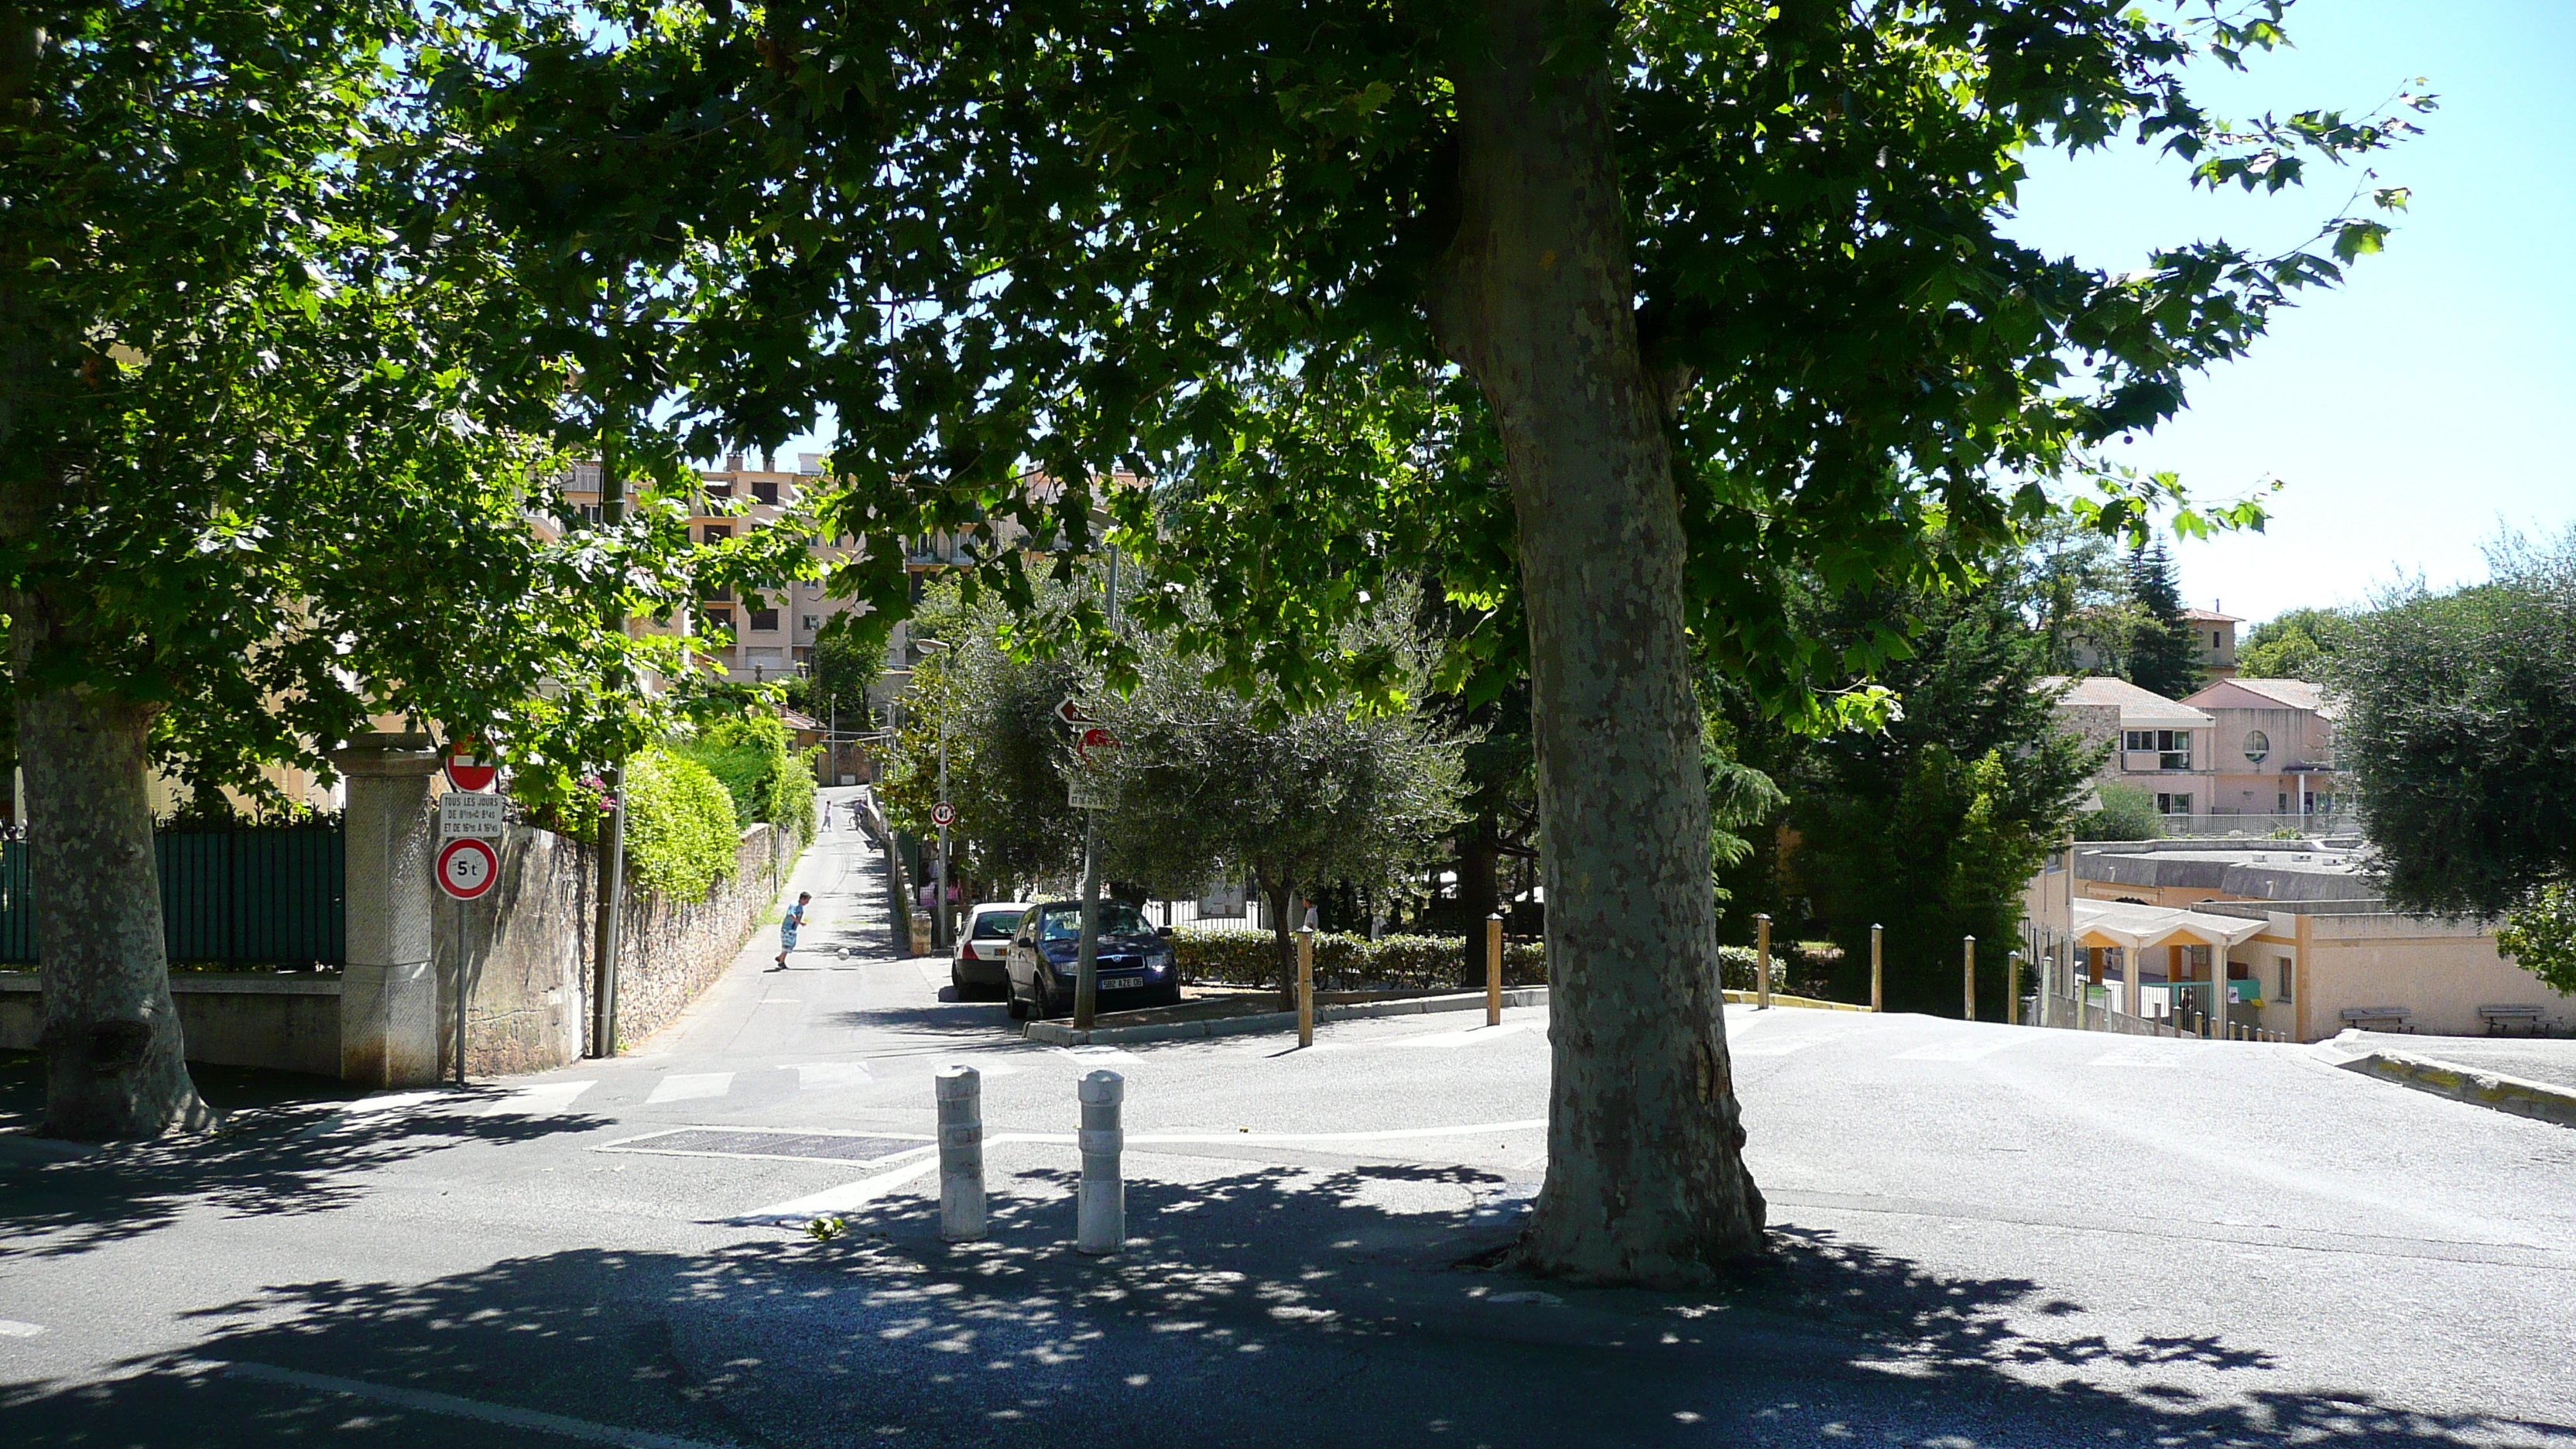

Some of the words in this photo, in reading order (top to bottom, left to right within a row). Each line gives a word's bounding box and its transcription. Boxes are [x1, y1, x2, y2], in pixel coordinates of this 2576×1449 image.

[445, 796, 461, 807] TOUS
[464, 796, 475, 807] LES
[478, 797, 498, 807] JOURS
[448, 810, 457, 819] DE
[444, 823, 451, 832] ET
[454, 823, 461, 832] DE
